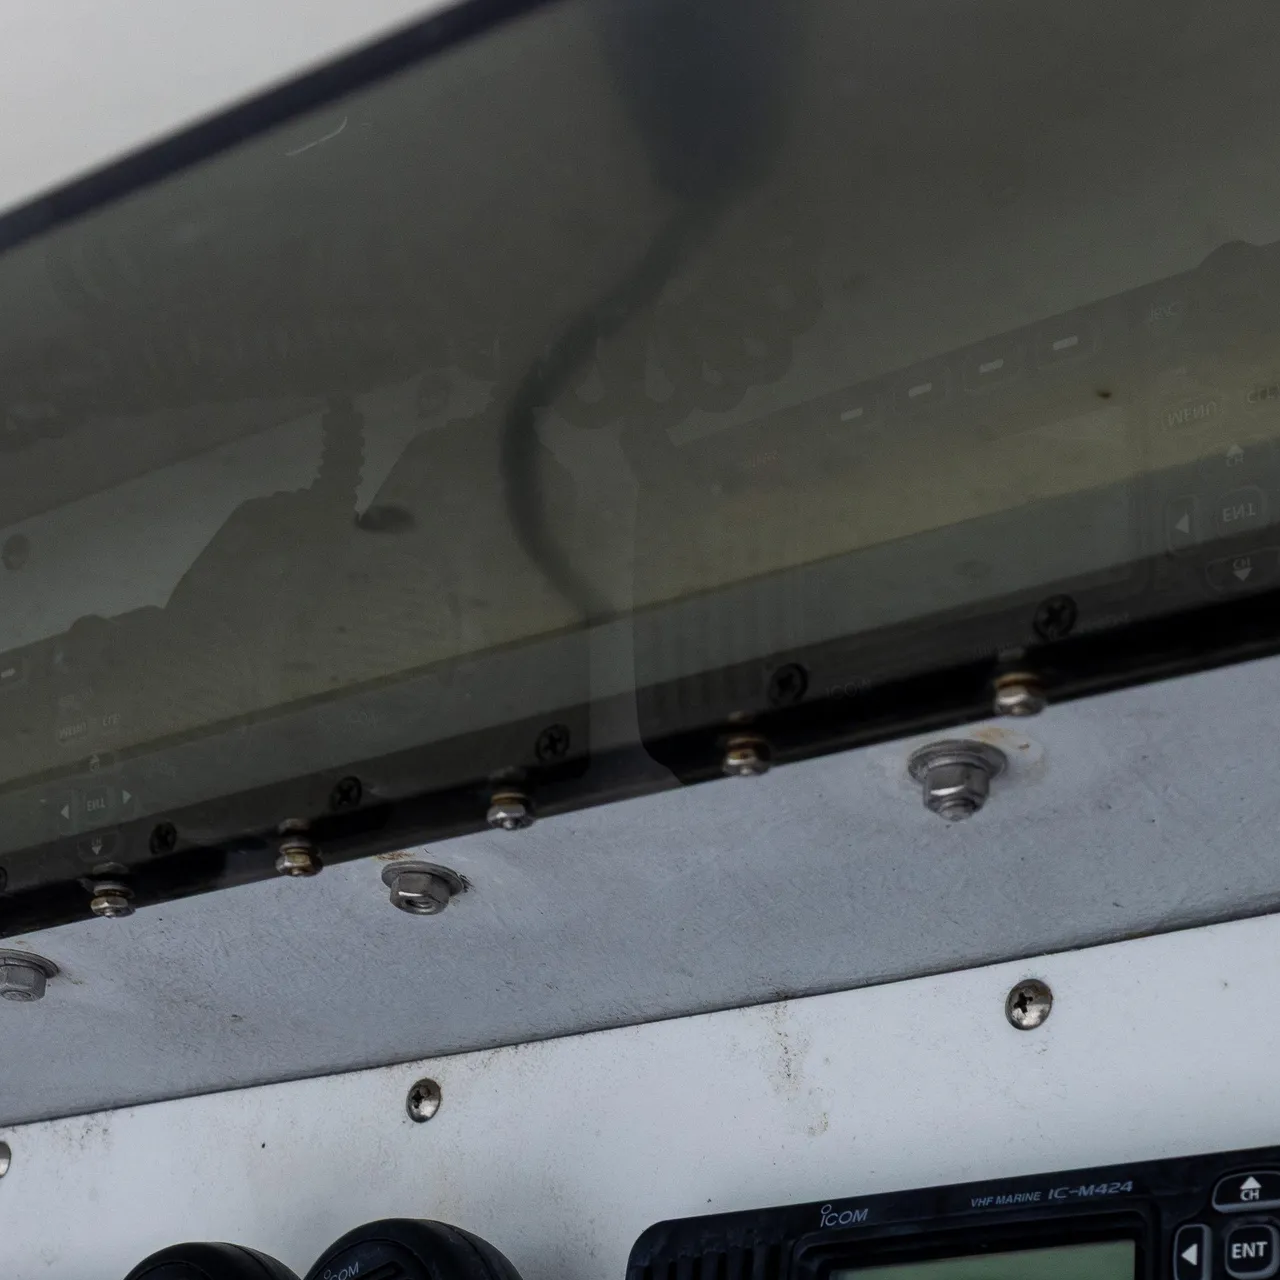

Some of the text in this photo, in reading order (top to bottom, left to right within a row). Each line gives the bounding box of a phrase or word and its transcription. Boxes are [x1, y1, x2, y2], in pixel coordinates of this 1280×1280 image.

[970, 1180, 1134, 1208] VHF MARINE IC-M424
[1239, 1188, 1260, 1201] CH
[1231, 1241, 1268, 1260] ENT
